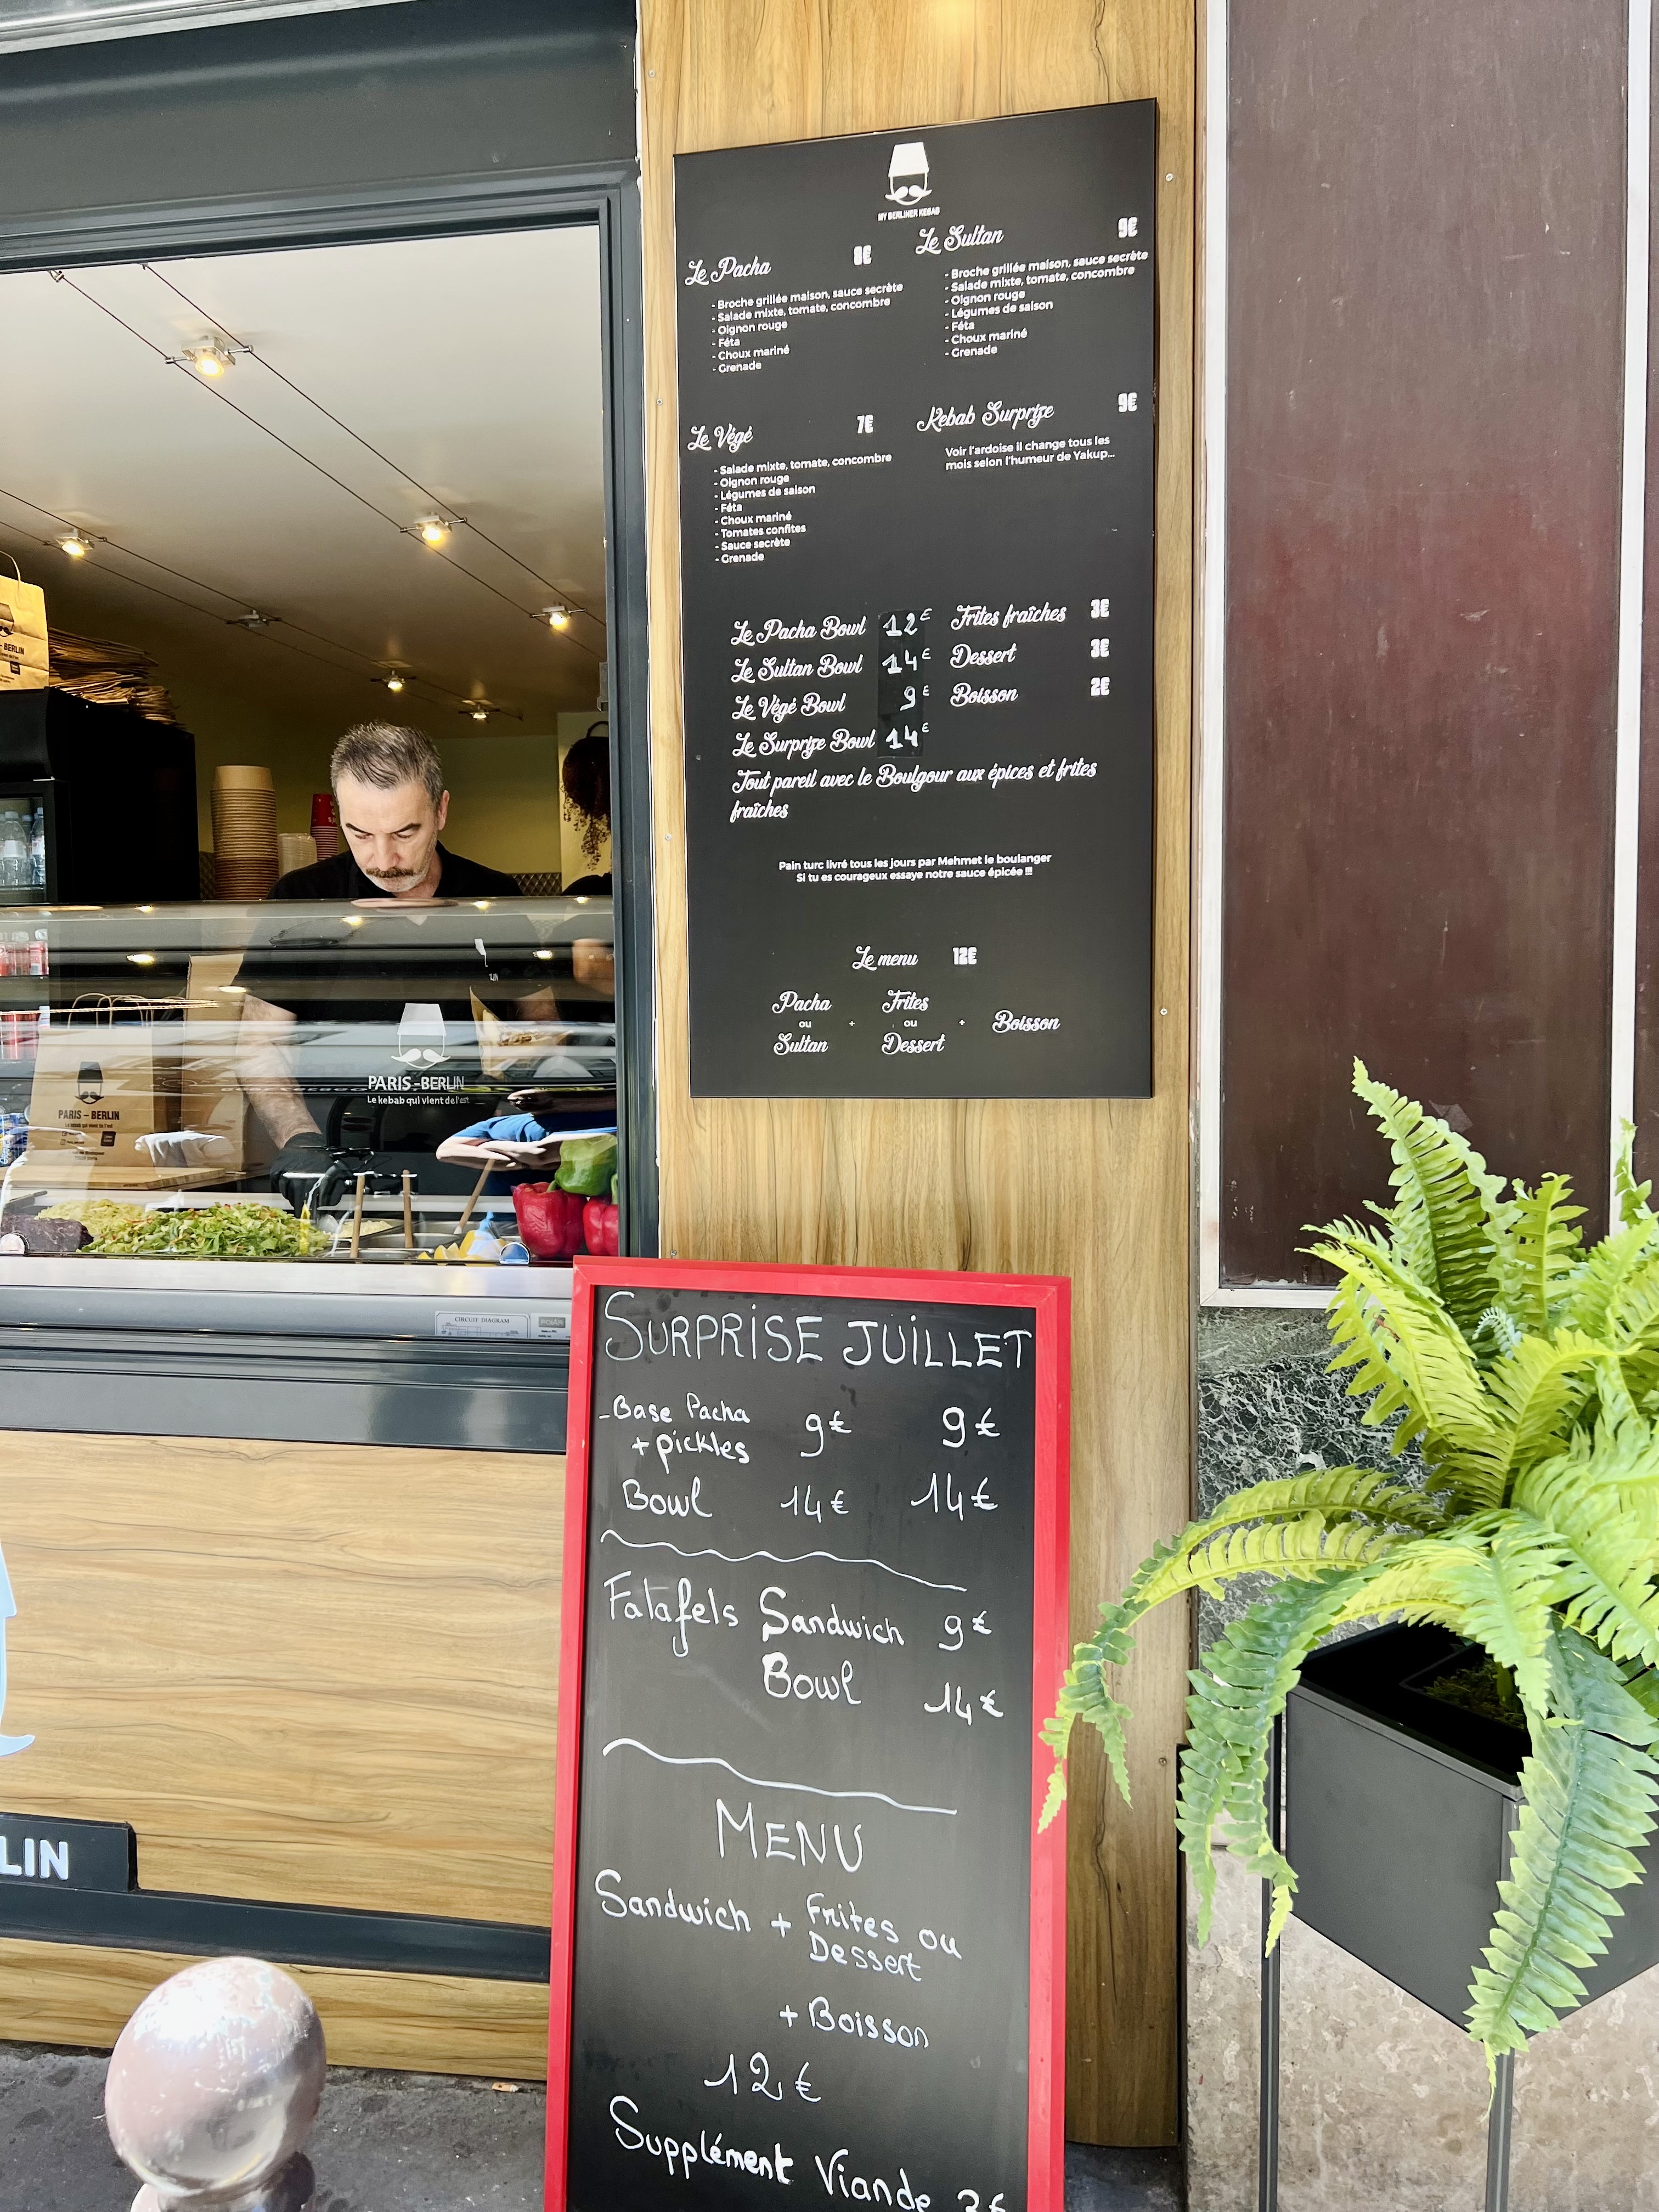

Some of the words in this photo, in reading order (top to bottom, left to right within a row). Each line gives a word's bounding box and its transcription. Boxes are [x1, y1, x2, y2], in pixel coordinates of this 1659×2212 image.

[878, 212, 887, 221] MY
[888, 209, 918, 220] BERLINER
[919, 207, 940, 217] KEBAB
[916, 228, 941, 254] Le
[944, 225, 1004, 251] Sultan
[685, 259, 709, 285] Le
[710, 256, 771, 282] Pacha
[718, 297, 754, 309] Broche
[756, 294, 788, 307] grillée
[791, 291, 830, 302] maison,
[833, 288, 862, 298] sauce
[865, 283, 903, 295] secrète
[718, 310, 752, 321] Salade
[754, 308, 786, 318] mixte,
[788, 304, 828, 315] tomate,
[831, 297, 890, 311] concombre
[952, 306, 1000, 319] Légumes
[1002, 303, 1017, 313] de
[1019, 301, 1053, 312] saison
[718, 324, 755, 336] Oignon
[758, 321, 787, 331] rouge
[718, 351, 751, 360] Choux
[753, 345, 789, 357] mariné
[719, 337, 740, 347] Féta
[719, 360, 761, 373] Grenade
[917, 405, 975, 432] Kebab
[687, 426, 712, 450] Le
[714, 424, 753, 453] Végé
[945, 446, 967, 456] Voir
[969, 443, 1013, 455] l'ardoise
[1017, 442, 1022, 451] il
[1025, 441, 1065, 450] change
[1068, 438, 1092, 447] tous
[1095, 436, 1110, 445] les
[946, 459, 972, 470] mois
[974, 458, 1002, 467] selon
[1006, 454, 1054, 465] l'humeur
[1057, 452, 1071, 461] de
[721, 527, 764, 538] Tomates
[766, 524, 806, 535] confites
[721, 541, 752, 550] Sauce
[754, 537, 790, 548] secrète
[951, 605, 1000, 630] Frites
[1002, 602, 1066, 628] fraîches
[731, 620, 755, 646] Le
[756, 619, 817, 643] Pacha
[820, 616, 866, 640] Bowl
[4, 642, 24, 655] BERLIN
[950, 643, 1017, 668] Dessert
[731, 658, 755, 683] Le
[758, 657, 814, 681] Sultan
[817, 654, 863, 678] Bowl
[950, 683, 1018, 707] Boisson
[732, 695, 756, 720] Le
[758, 695, 797, 723] Végé
[801, 692, 846, 716] Bowl
[732, 732, 757, 758] Le
[830, 729, 876, 752] Bowl
[732, 770, 771, 793] Tout
[770, 769, 817, 797] pareil
[820, 774, 854, 787] avec
[857, 767, 872, 786] le
[876, 764, 953, 792] Boulgour
[956, 769, 985, 782] aux
[988, 763, 1034, 788] épices
[1039, 759, 1056, 777] et
[1056, 758, 1097, 781] frites
[730, 799, 788, 822] fraîches
[780, 861, 801, 870] Pain
[803, 861, 823, 870] turc
[827, 860, 848, 869] livré
[874, 859, 888, 867] les
[889, 858, 916, 869] jours
[918, 859, 936, 868] par
[938, 856, 982, 865] Mehmet
[985, 855, 994, 864] le
[997, 854, 1052, 864] boulanger
[797, 873, 805, 882] Si
[808, 873, 819, 882] tu
[834, 873, 888, 882] courageux
[890, 872, 923, 881] essaye
[926, 870, 953, 878] notre
[988, 867, 1023, 878] épicée
[853, 946, 877, 970] Le
[878, 955, 918, 966] menu
[772, 991, 832, 1013] Pacha
[882, 990, 929, 1013] Frites
[992, 1010, 1060, 1033] Boisson
[774, 1033, 828, 1055] Sultan
[882, 1032, 945, 1054] Dessert
[368, 1076, 411, 1091] PARIS
[379, 1096, 404, 1104] kebab
[407, 1096, 420, 1106] qui
[422, 1096, 445, 1104] vient
[445, 1096, 455, 1104] de
[59, 1110, 81, 1119] PARIS
[92, 1111, 120, 1120] BERLIN
[687, 1392, 750, 1423] Pacha
[657, 1430, 749, 1474] pickles
[623, 1476, 712, 1517] Bowl
[604, 1571, 738, 1657] Falafels
[760, 1587, 904, 1645] Sandwich
[762, 1652, 861, 1704] Bowl
[716, 1799, 862, 1873] MENU
[0, 1836, 69, 1881] LIN
[595, 1869, 751, 1932] Sandwich
[807, 1893, 899, 1943] Frites
[919, 1926, 962, 1960] ou
[809, 1931, 922, 1983] Dessert
[809, 1996, 929, 2048] Boisson
[610, 2096, 793, 2184] Supplément
[815, 2149, 930, 2212] Viande
